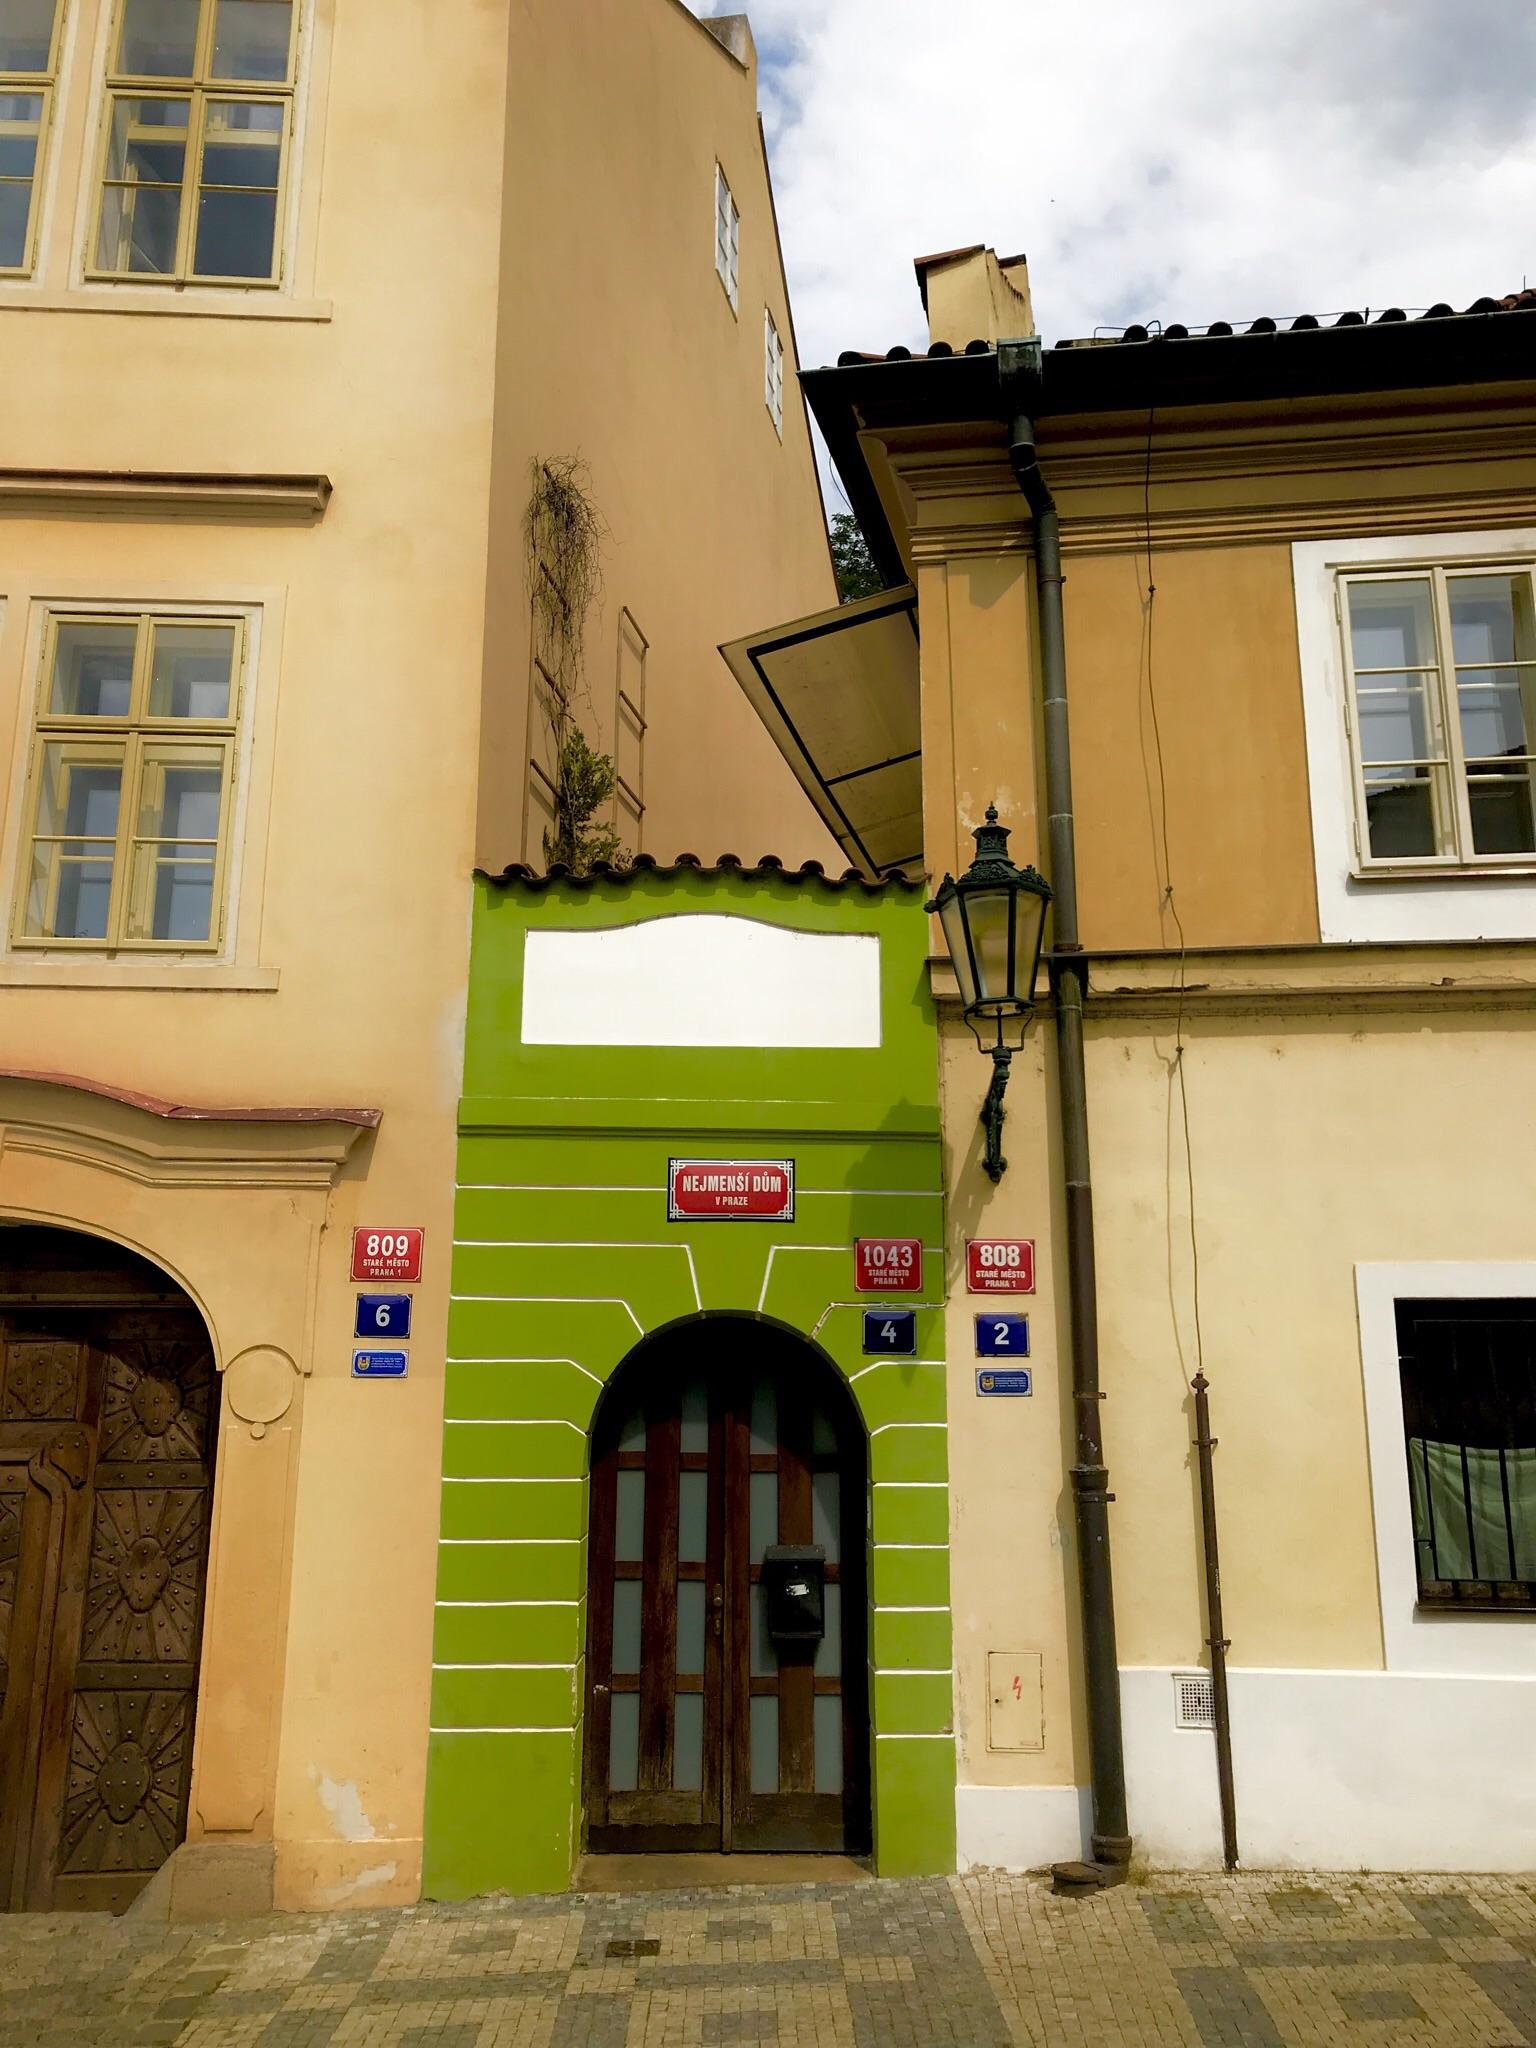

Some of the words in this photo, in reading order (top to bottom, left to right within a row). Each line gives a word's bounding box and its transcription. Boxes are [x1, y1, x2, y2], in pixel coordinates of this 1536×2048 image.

[682, 1172, 750, 1192] NEJMENŠÍ
[753, 1171, 782, 1192] DŮM
[715, 1197, 721, 1206] V
[722, 1197, 749, 1206] PRAZE
[367, 1235, 409, 1256] 809
[863, 1245, 913, 1267] 1043
[980, 1245, 1020, 1267] 808
[363, 1257, 384, 1267] STARÉ
[387, 1258, 410, 1267] MĚSTO
[868, 1268, 888, 1277] STARÉ
[889, 1268, 910, 1277] MĚSTO
[873, 1277, 898, 1285] PRAHA
[976, 1269, 999, 1278] STARÉ
[1001, 1269, 1026, 1278] MĚSTO
[985, 1280, 1010, 1288] PRAHA
[376, 1304, 391, 1327] 6
[880, 1320, 897, 1344] 4
[993, 1322, 1010, 1345] 2
